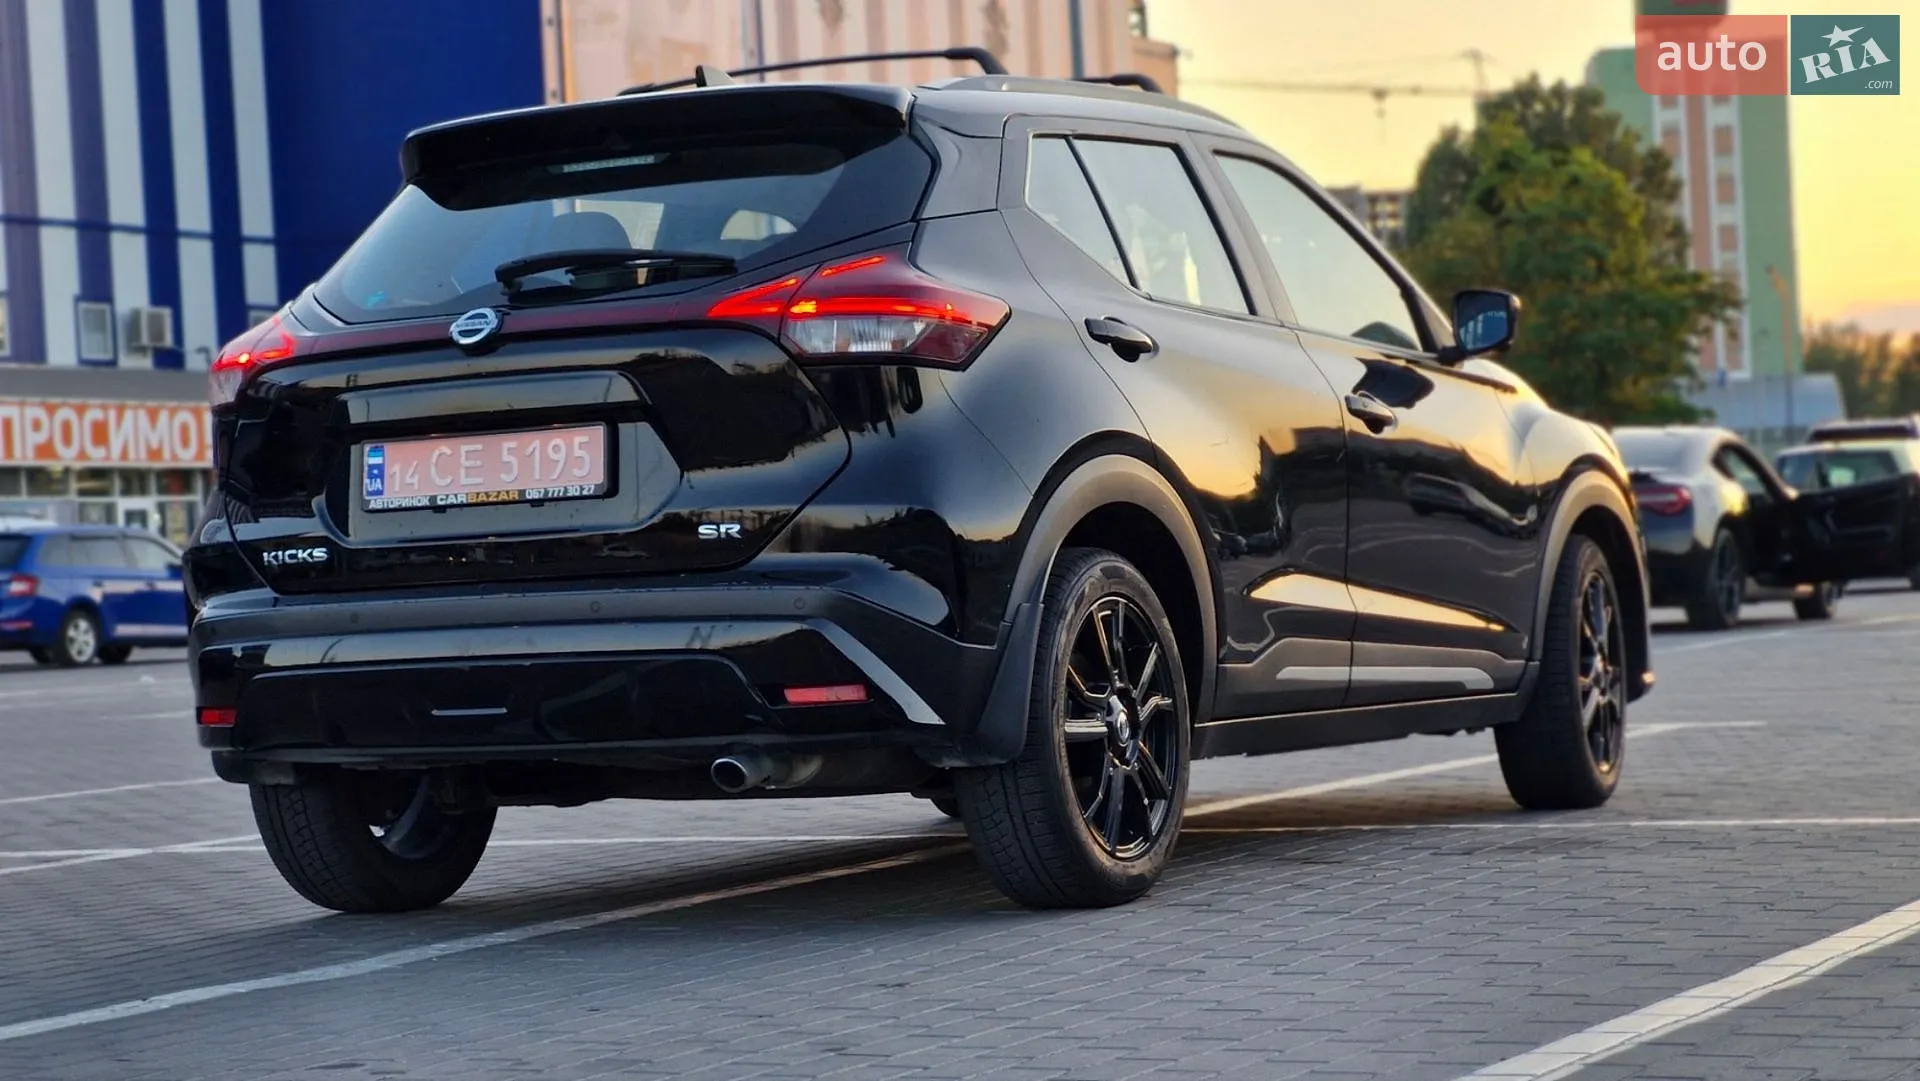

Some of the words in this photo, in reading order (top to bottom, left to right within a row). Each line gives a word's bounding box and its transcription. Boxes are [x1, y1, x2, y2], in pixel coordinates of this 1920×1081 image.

[388, 459, 420, 492] 14
[430, 443, 484, 487] CE
[500, 435, 593, 483] 5195
[366, 479, 383, 492] UA
[436, 490, 519, 505] CARBAZAR
[698, 523, 742, 539] SR
[262, 547, 328, 566] KICKS
